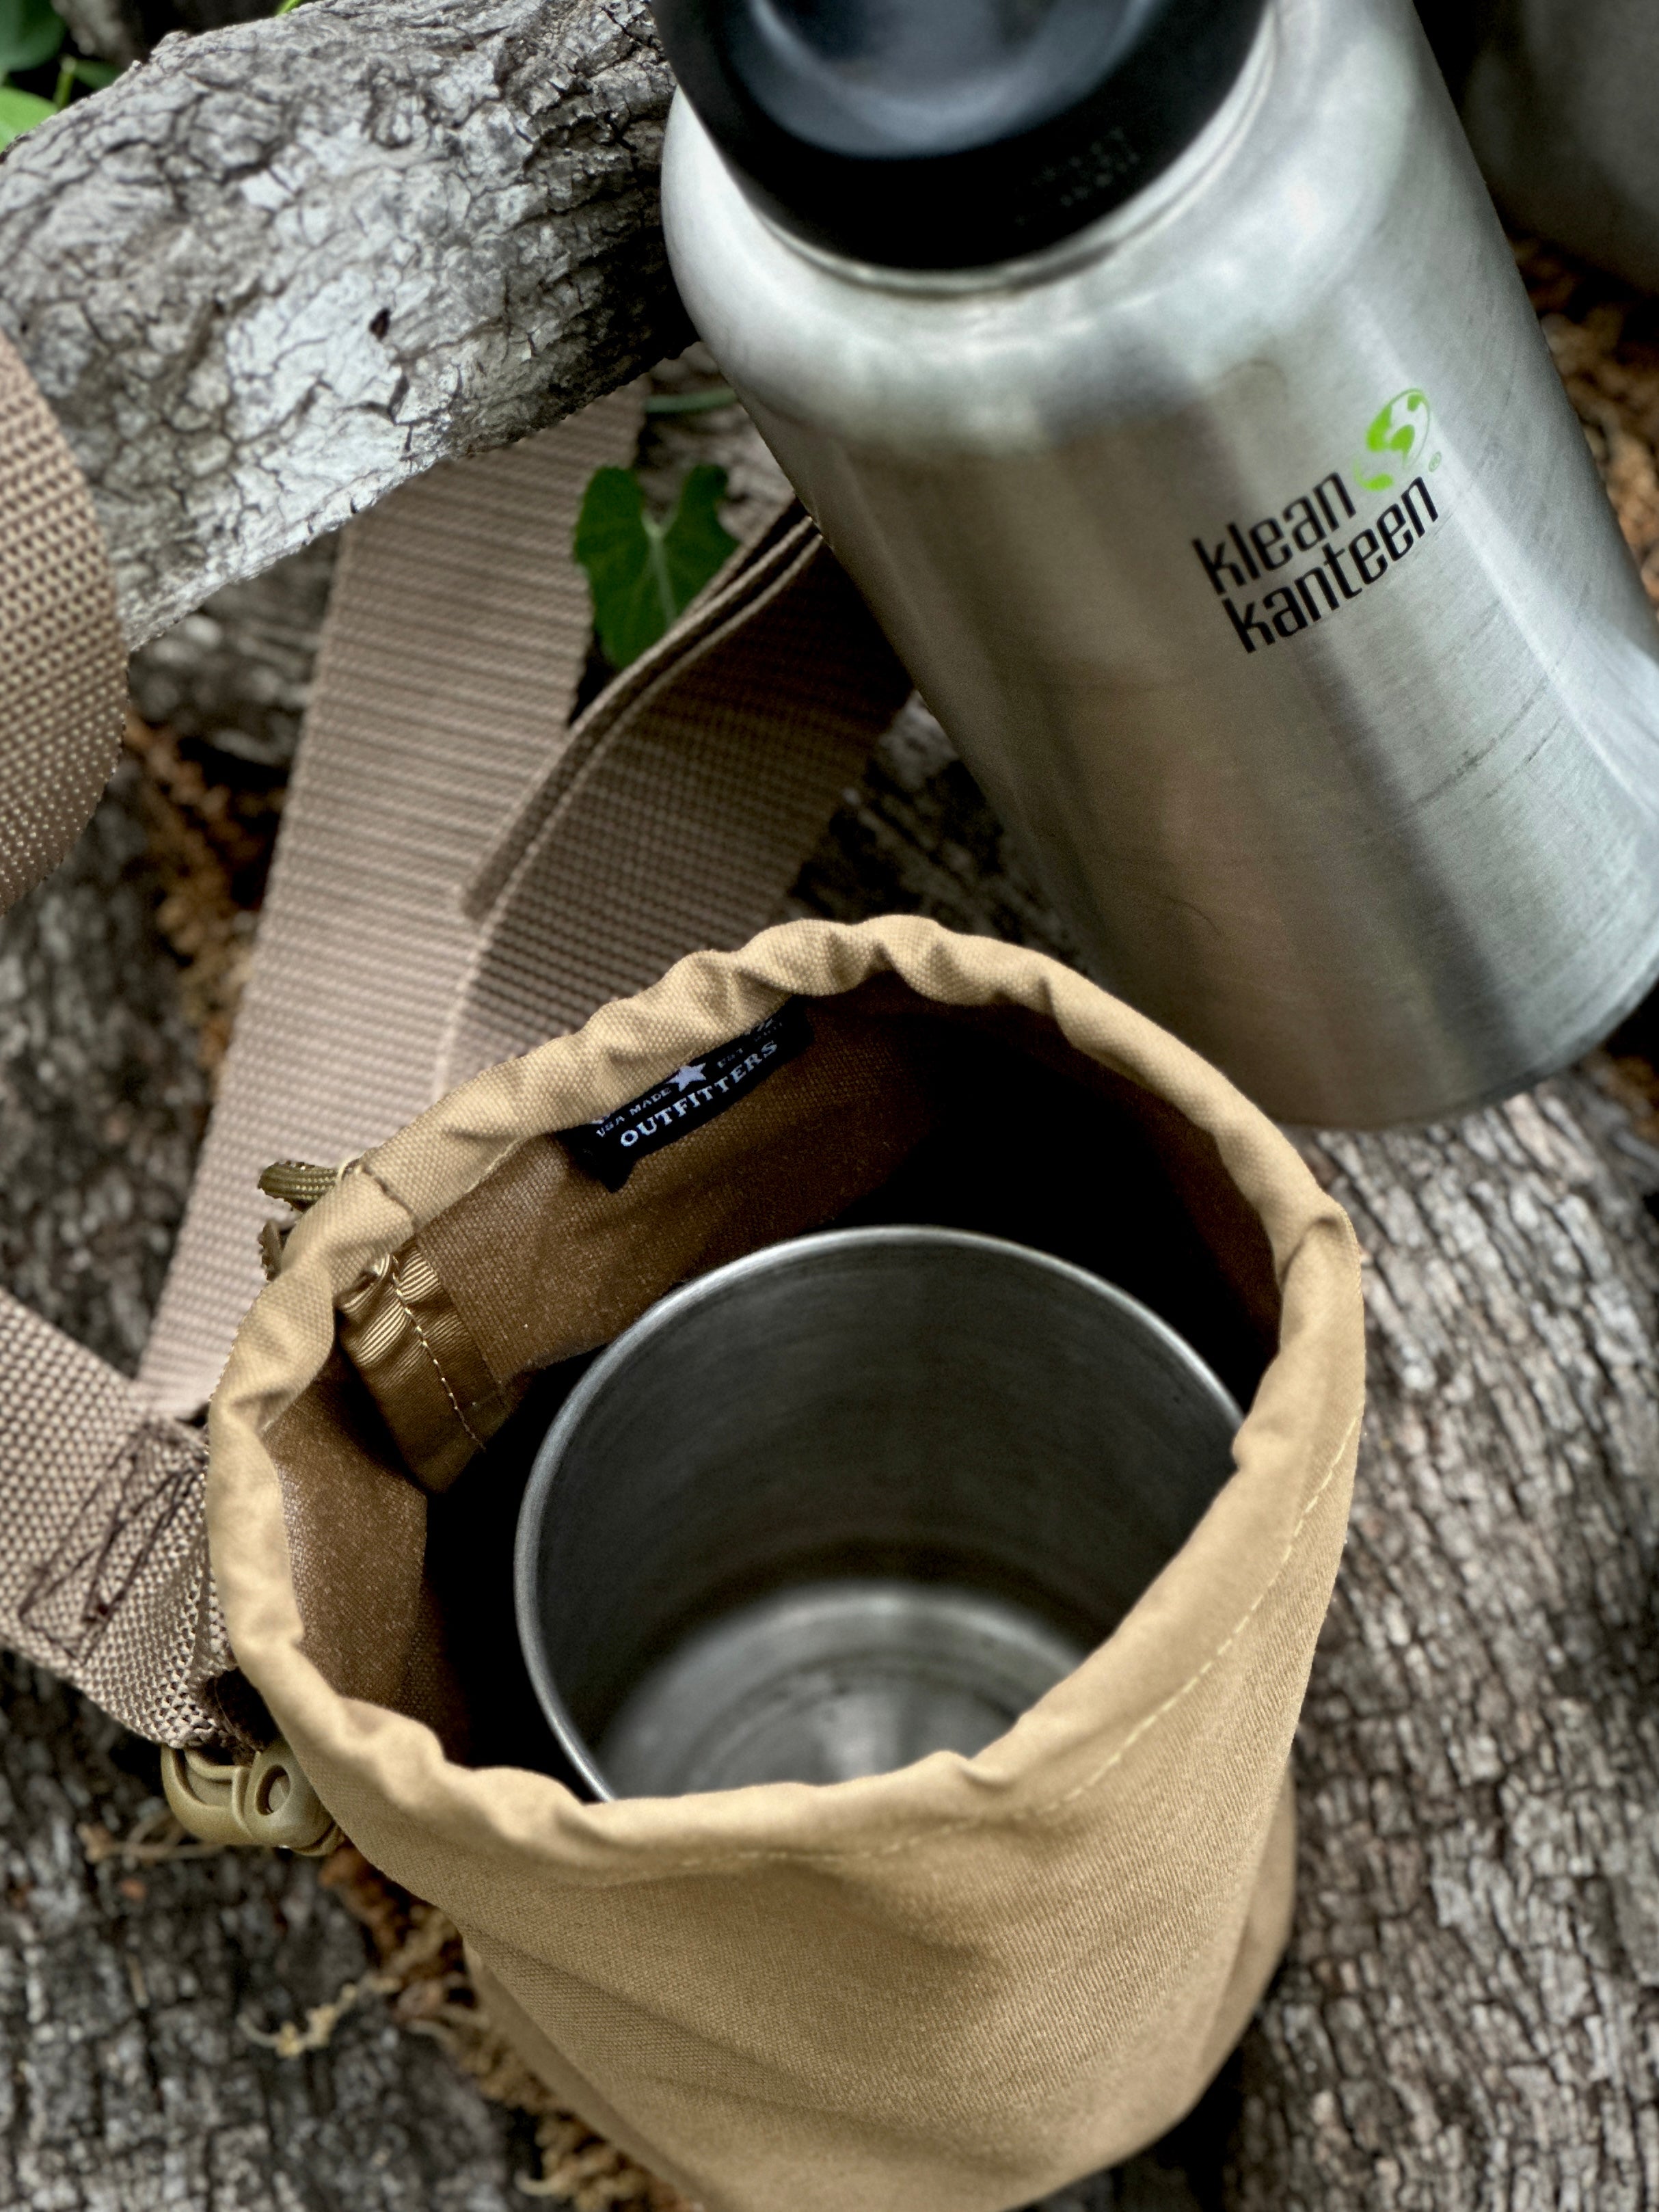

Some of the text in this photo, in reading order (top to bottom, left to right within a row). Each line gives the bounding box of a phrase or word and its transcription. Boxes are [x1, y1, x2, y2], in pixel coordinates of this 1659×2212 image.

[1191, 472, 1356, 595] klean
[1222, 476, 1439, 653] kanteen
[620, 1040, 777, 1147] OUTFITTERS
[630, 1088, 671, 1116] MADE
